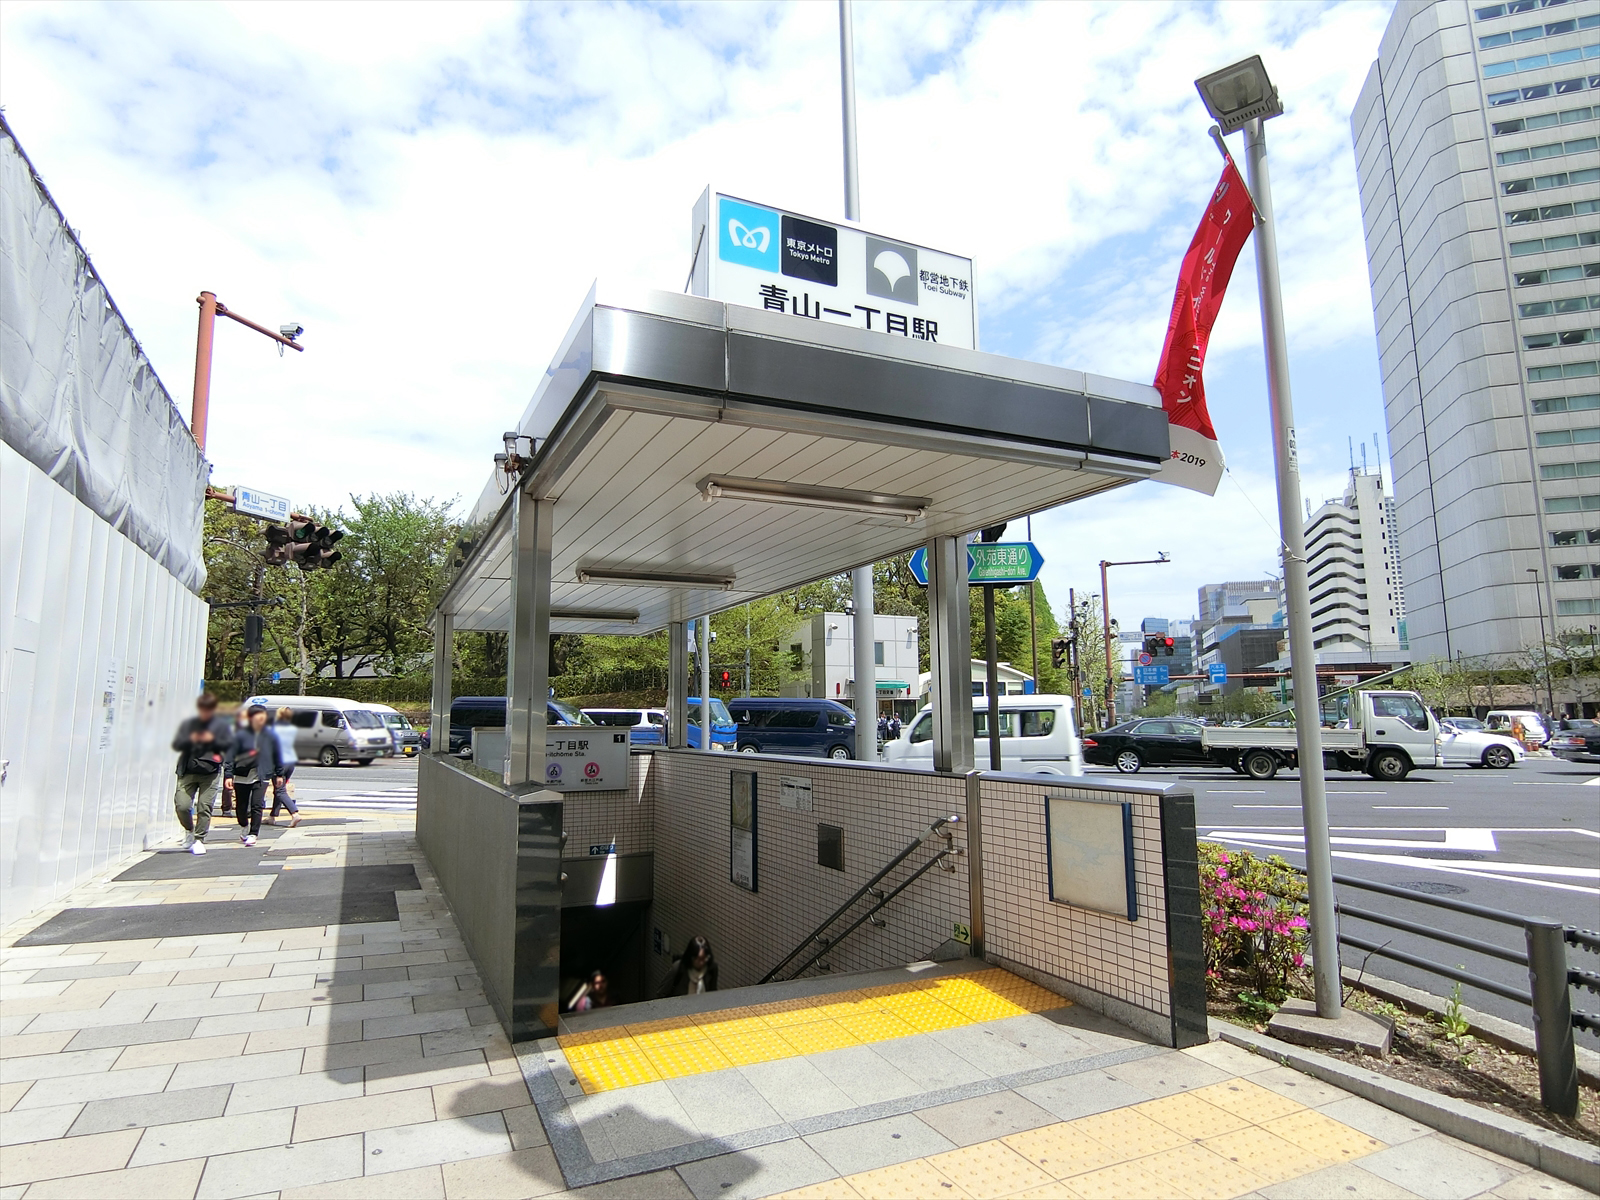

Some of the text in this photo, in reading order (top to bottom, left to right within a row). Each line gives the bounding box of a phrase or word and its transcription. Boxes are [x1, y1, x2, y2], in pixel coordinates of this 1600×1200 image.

[786, 237, 833, 258] 東京メトロ
[789, 248, 830, 265] Tokyo Metro
[919, 269, 969, 292] 都営地下鉄
[923, 282, 966, 300] Toei Subway
[759, 284, 938, 342] 青山一丁目駅
[1180, 452, 1206, 468] 2019
[242, 491, 287, 512] 青山一丁目
[242, 501, 285, 517] Aoyama 1-chome
[976, 548, 1028, 566] 外苑東通り
[616, 734, 621, 743] 1
